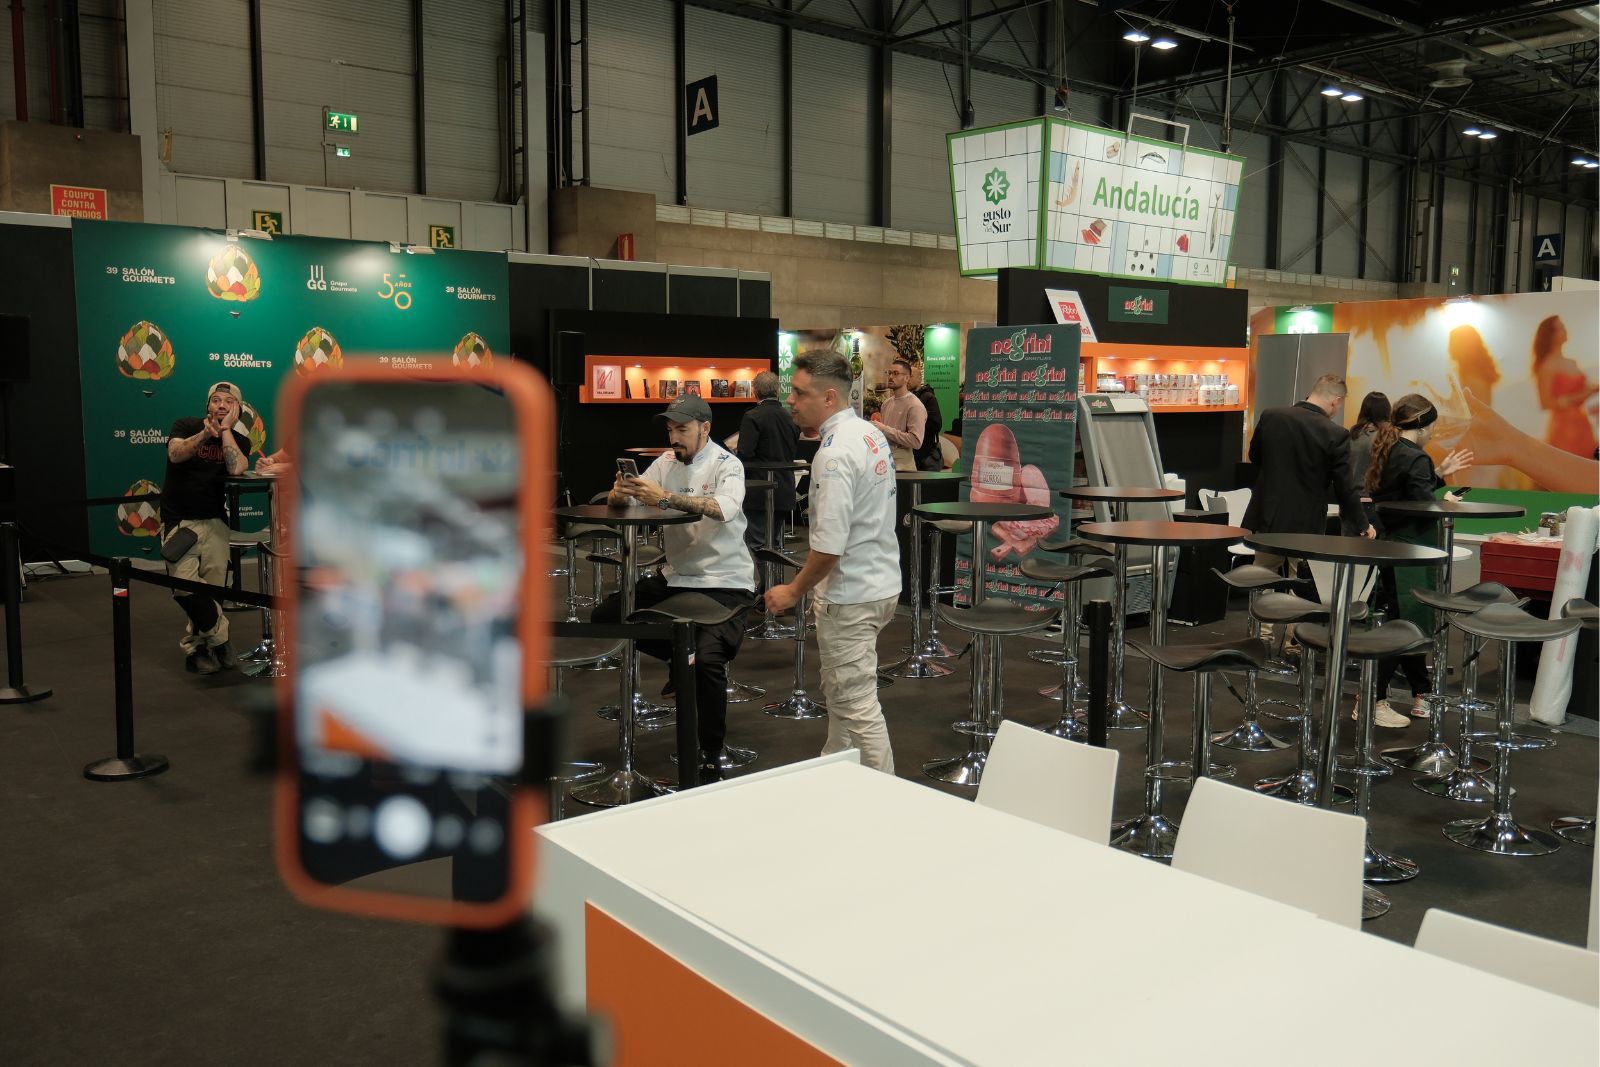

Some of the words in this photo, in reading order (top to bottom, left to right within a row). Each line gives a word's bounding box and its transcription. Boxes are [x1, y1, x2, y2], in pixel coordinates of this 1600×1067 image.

[692, 87, 713, 127] A
[63, 189, 95, 200] EQUIPO
[1093, 176, 1200, 221] Andalucía
[61, 199, 96, 210] CONTRA
[57, 208, 102, 219] INCENDIOS
[983, 207, 1011, 226] gusto
[992, 220, 1011, 234] Sur
[1537, 238, 1556, 257] A
[106, 266, 118, 275] 39
[122, 266, 155, 276] SALÓN
[122, 275, 176, 284] GOURMETS
[457, 286, 481, 294] SALÓN
[457, 293, 497, 301] GOURMETS
[990, 328, 1052, 361] negrini
[208, 352, 220, 360] 39
[223, 352, 253, 361] SALÓN
[391, 355, 417, 364] SALÓN
[223, 360, 272, 368] GOURMETS
[975, 364, 1017, 387] negrini
[1021, 363, 1066, 387] negrini
[114, 430, 126, 438] 39
[129, 428, 162, 437] SALÓN
[130, 436, 169, 444] GOURME
